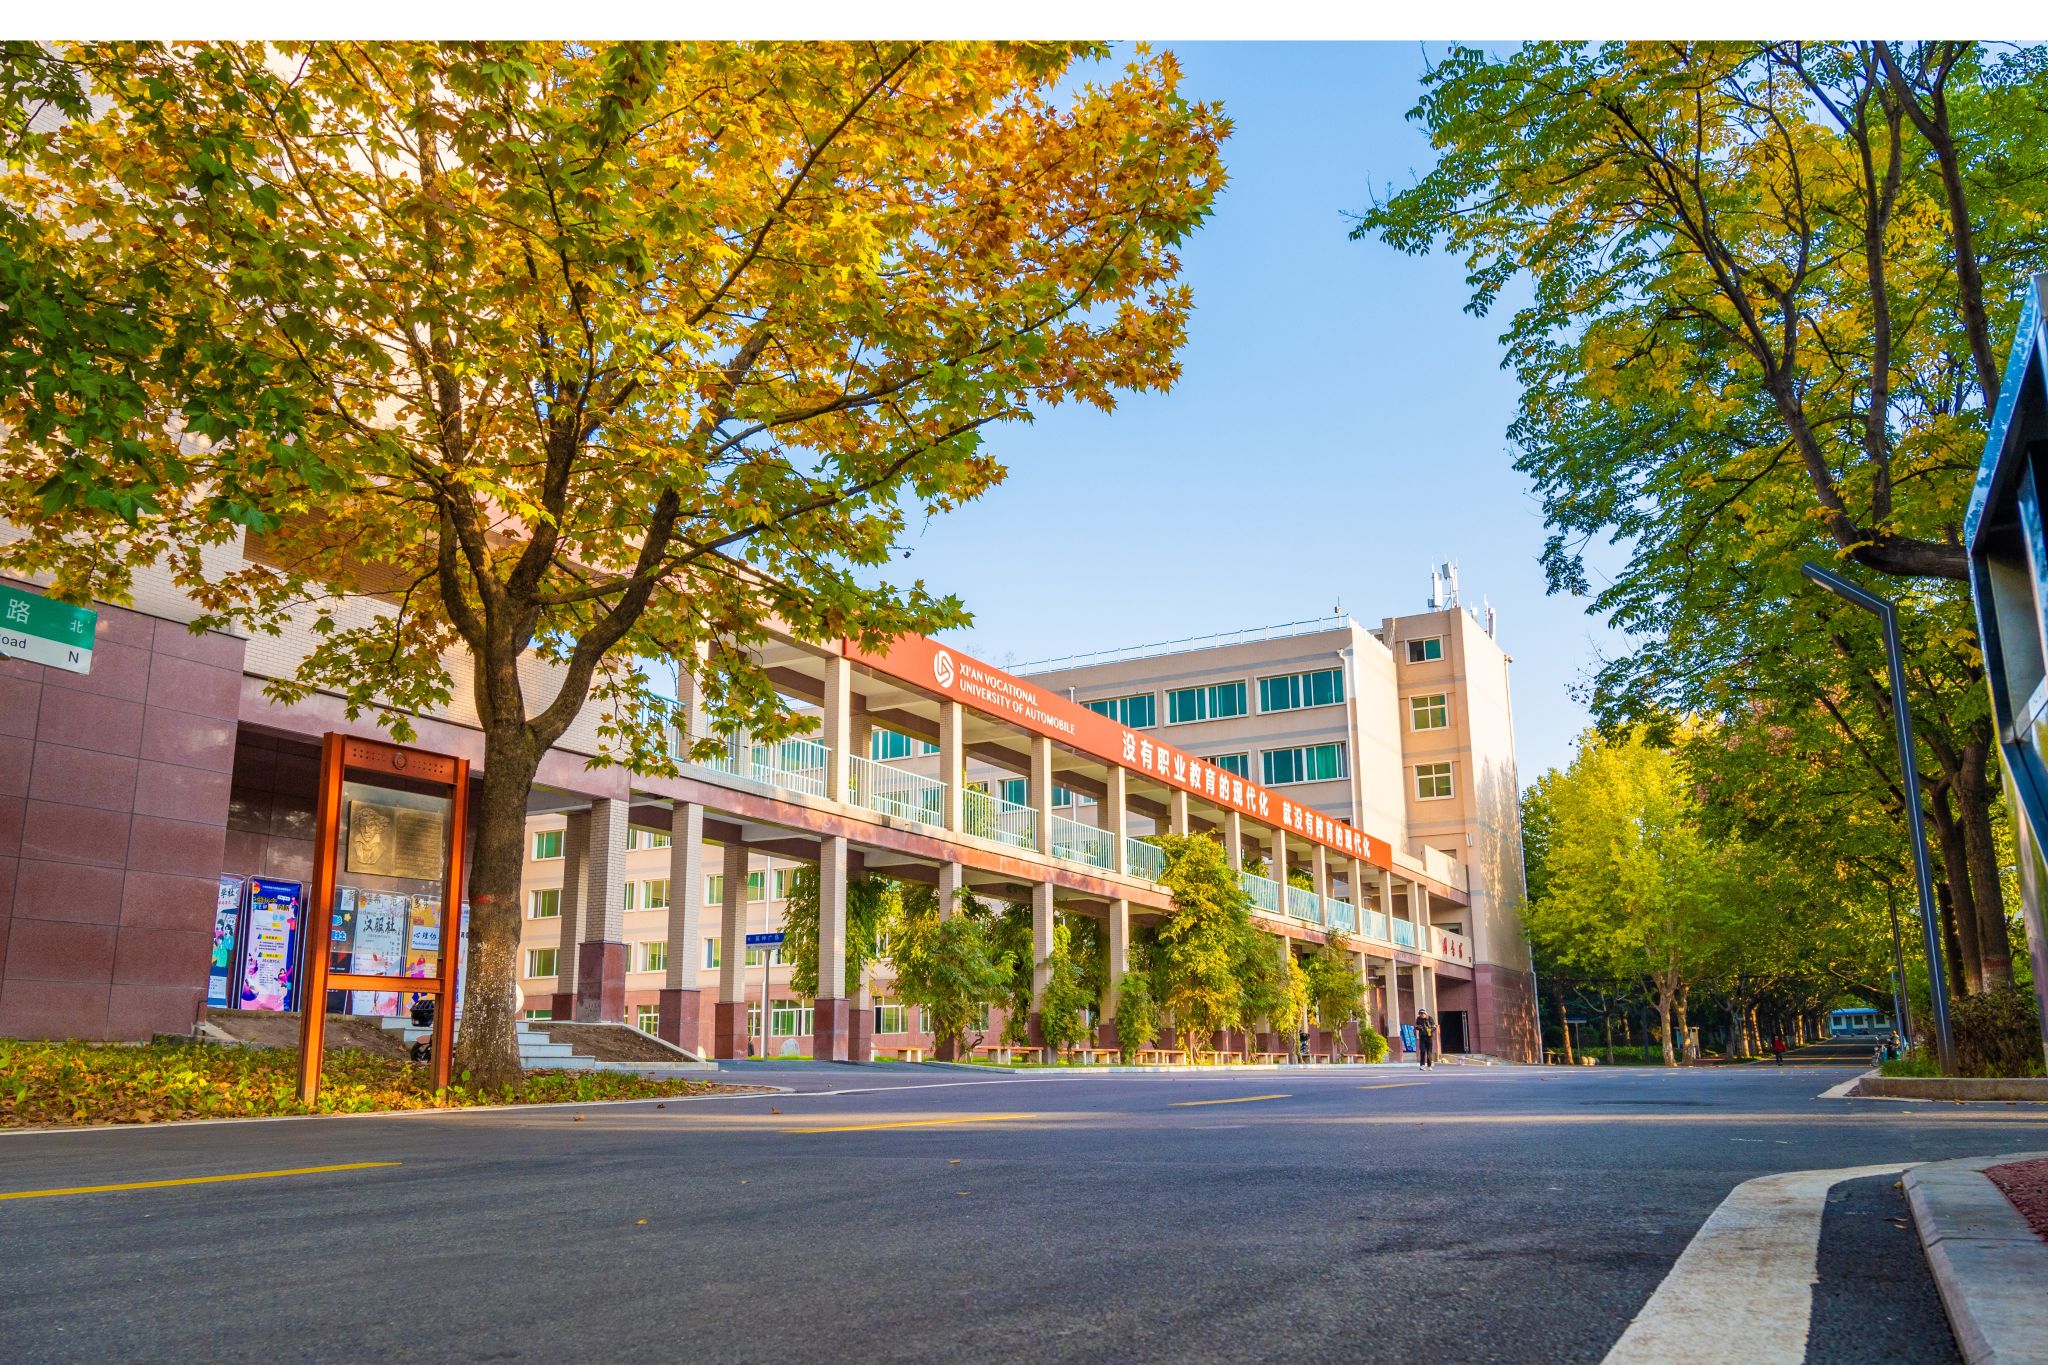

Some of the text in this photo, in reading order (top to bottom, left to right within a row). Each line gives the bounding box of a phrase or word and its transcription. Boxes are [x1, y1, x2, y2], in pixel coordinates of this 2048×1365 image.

[6, 598, 84, 634] 路 北
[0, 634, 79, 664] oad N
[959, 662, 1038, 706] XI'AN VOCATIONAL
[959, 679, 1076, 735] UNIVERSITY OF AUTOMOBILE
[1122, 730, 1370, 858] 没有职业教育的现代化 就没有教育的现代化
